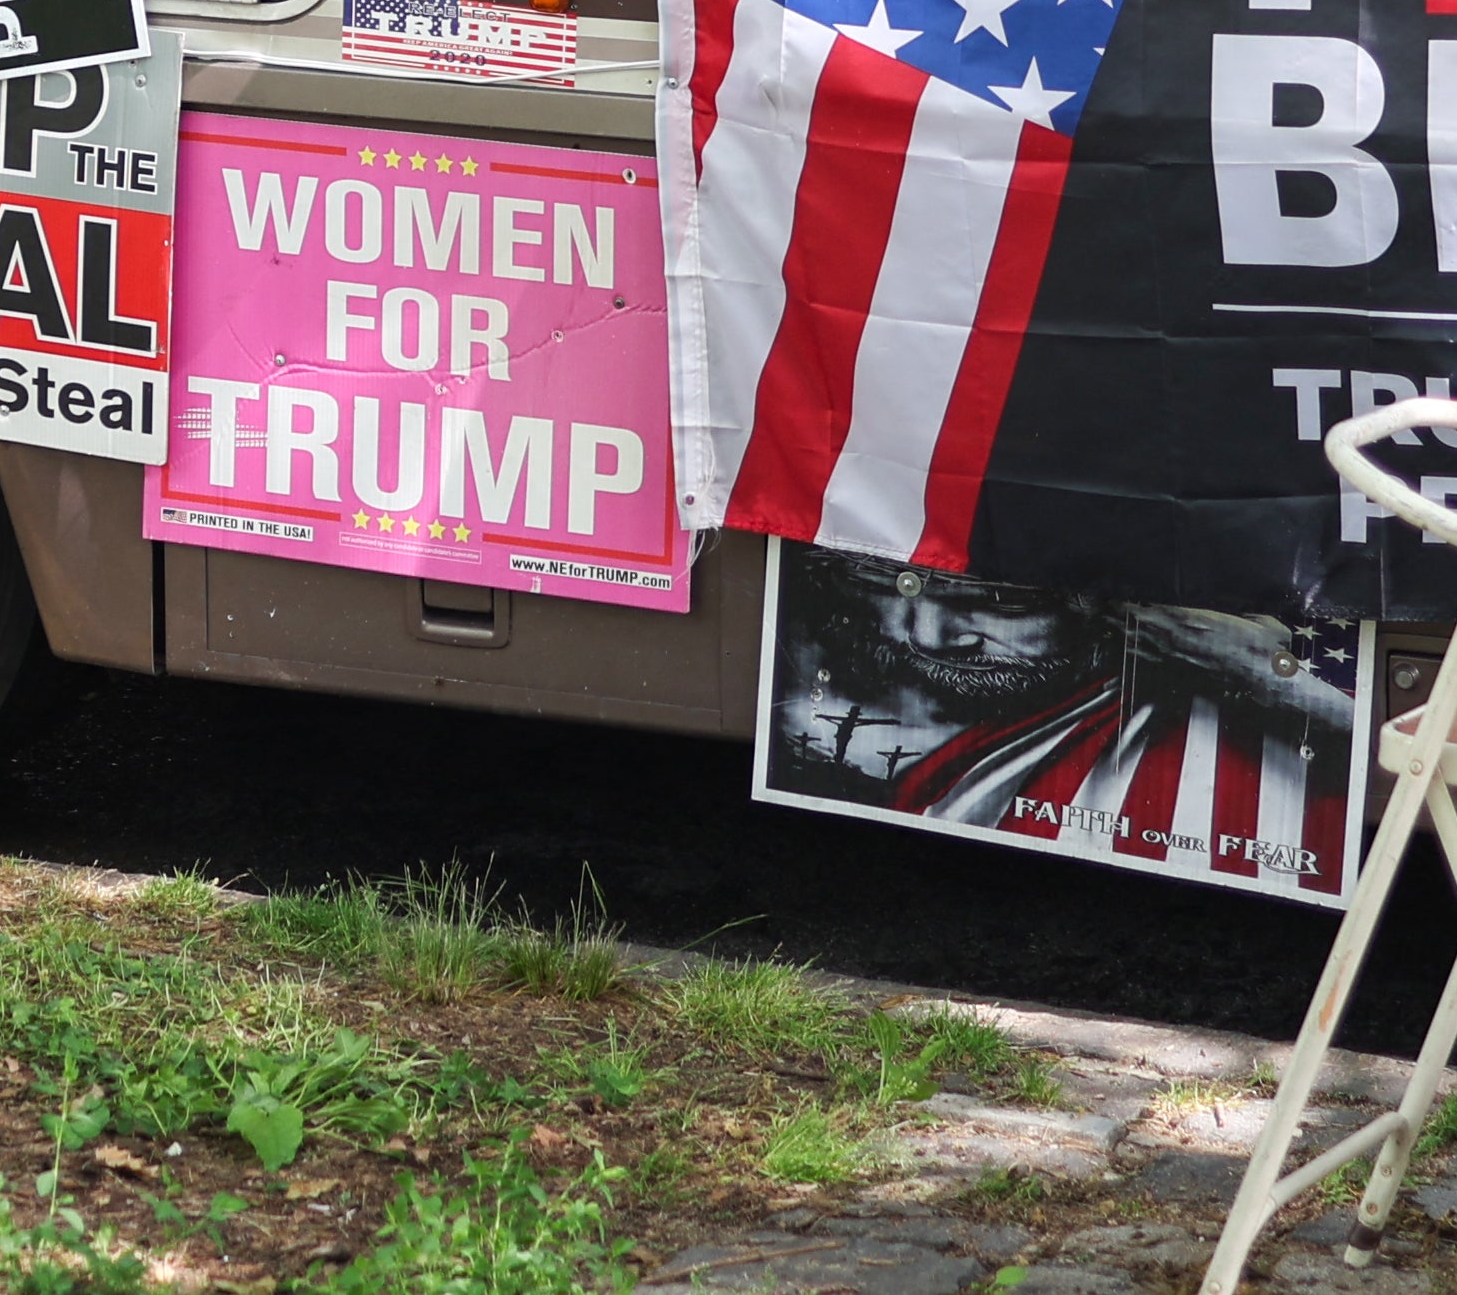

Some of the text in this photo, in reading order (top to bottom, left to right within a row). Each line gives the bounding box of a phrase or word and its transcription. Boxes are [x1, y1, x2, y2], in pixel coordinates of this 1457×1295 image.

[371, 10, 548, 48] TRUMP
[70, 146, 156, 194] THE
[221, 167, 616, 289] WOMEN
[325, 282, 512, 383] FOR
[187, 375, 644, 537] TRUMP
[189, 513, 313, 540] PRINTED IN THE USA!
[511, 557, 671, 589] www.NEforTRUMP.com
[1015, 795, 1322, 876] FAITH OVER FEAR
